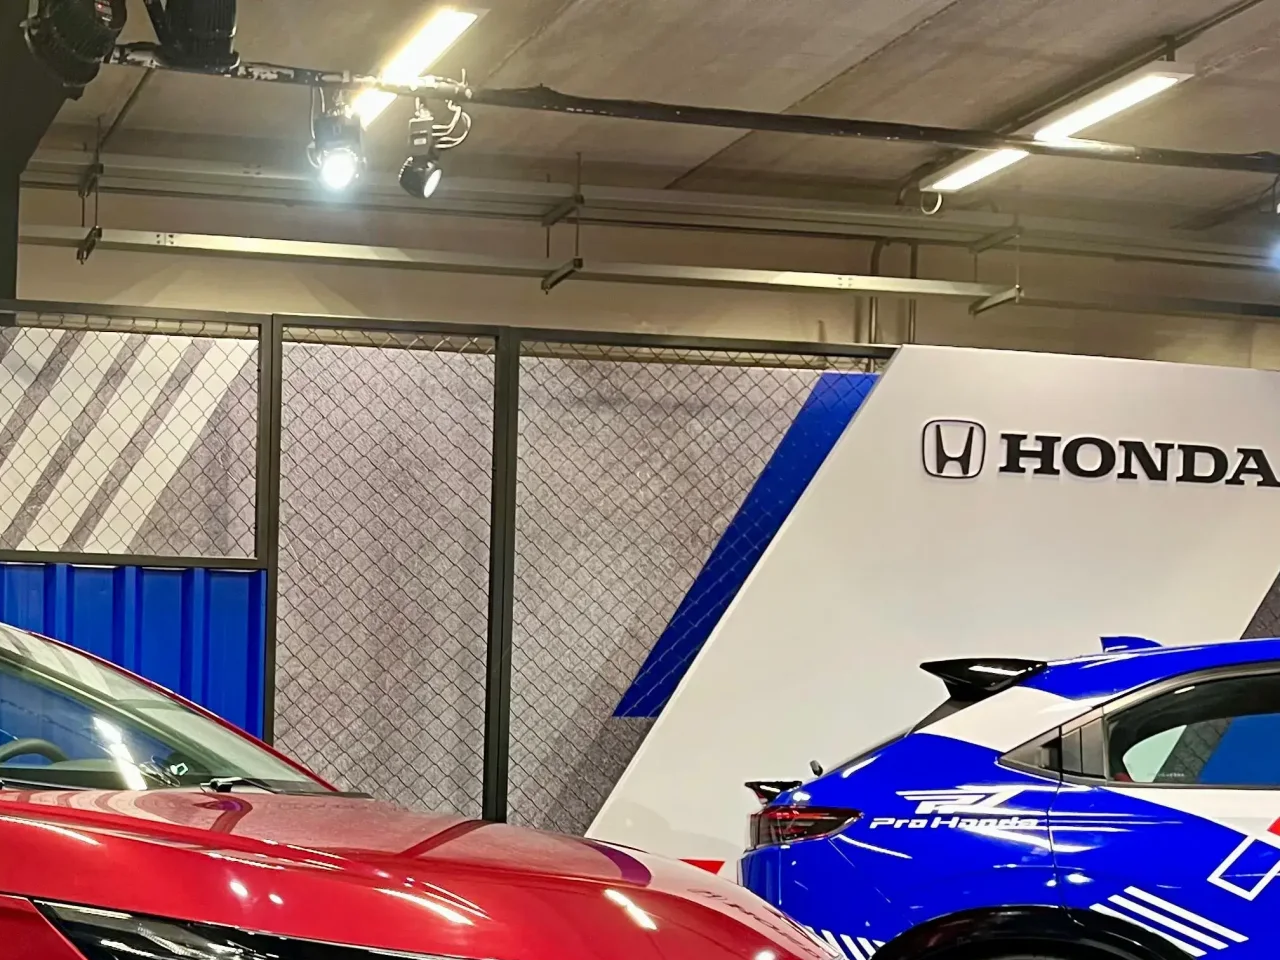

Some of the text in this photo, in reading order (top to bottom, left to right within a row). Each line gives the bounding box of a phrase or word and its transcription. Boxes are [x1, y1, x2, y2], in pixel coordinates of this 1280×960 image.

[999, 432, 1280, 488] HONDA
[869, 816, 1039, 829] Pro Honda
